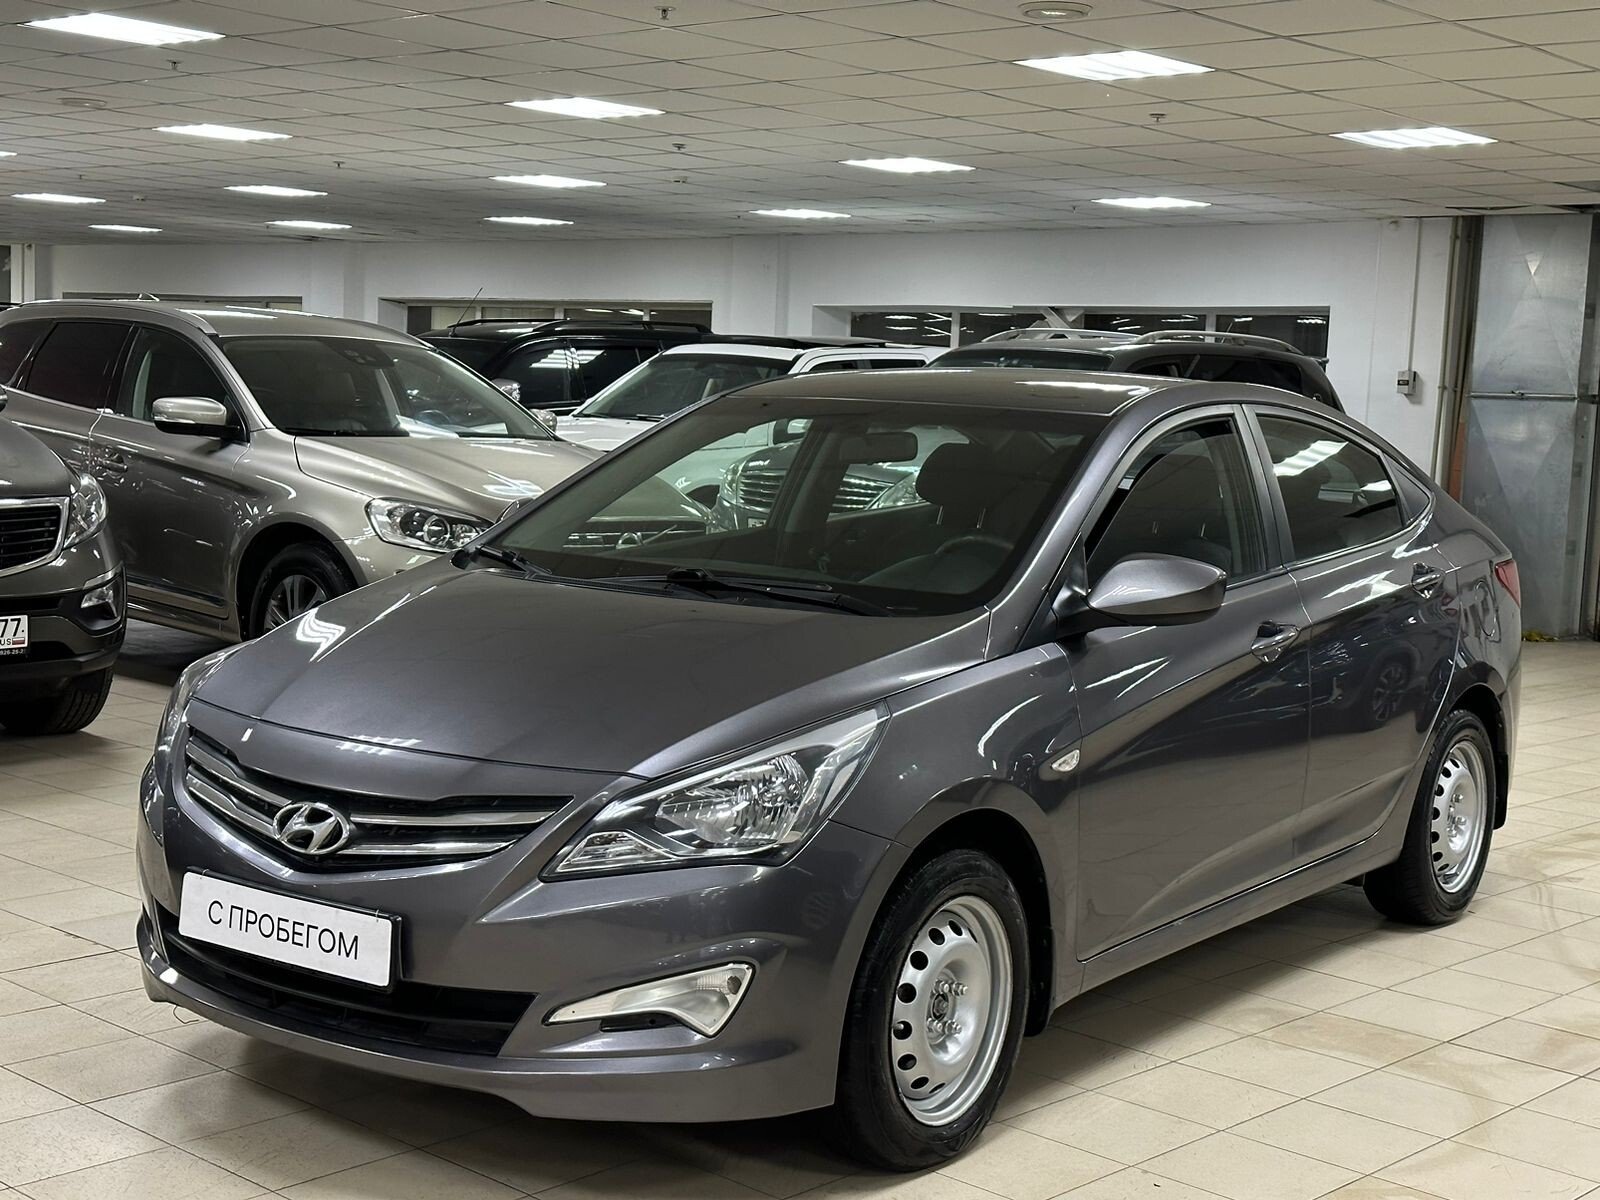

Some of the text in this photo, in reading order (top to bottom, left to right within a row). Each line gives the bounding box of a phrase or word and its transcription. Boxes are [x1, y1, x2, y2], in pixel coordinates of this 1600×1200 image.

[0, 618, 21, 637] 77
[208, 900, 359, 961] С ПРОБЕГОМ
